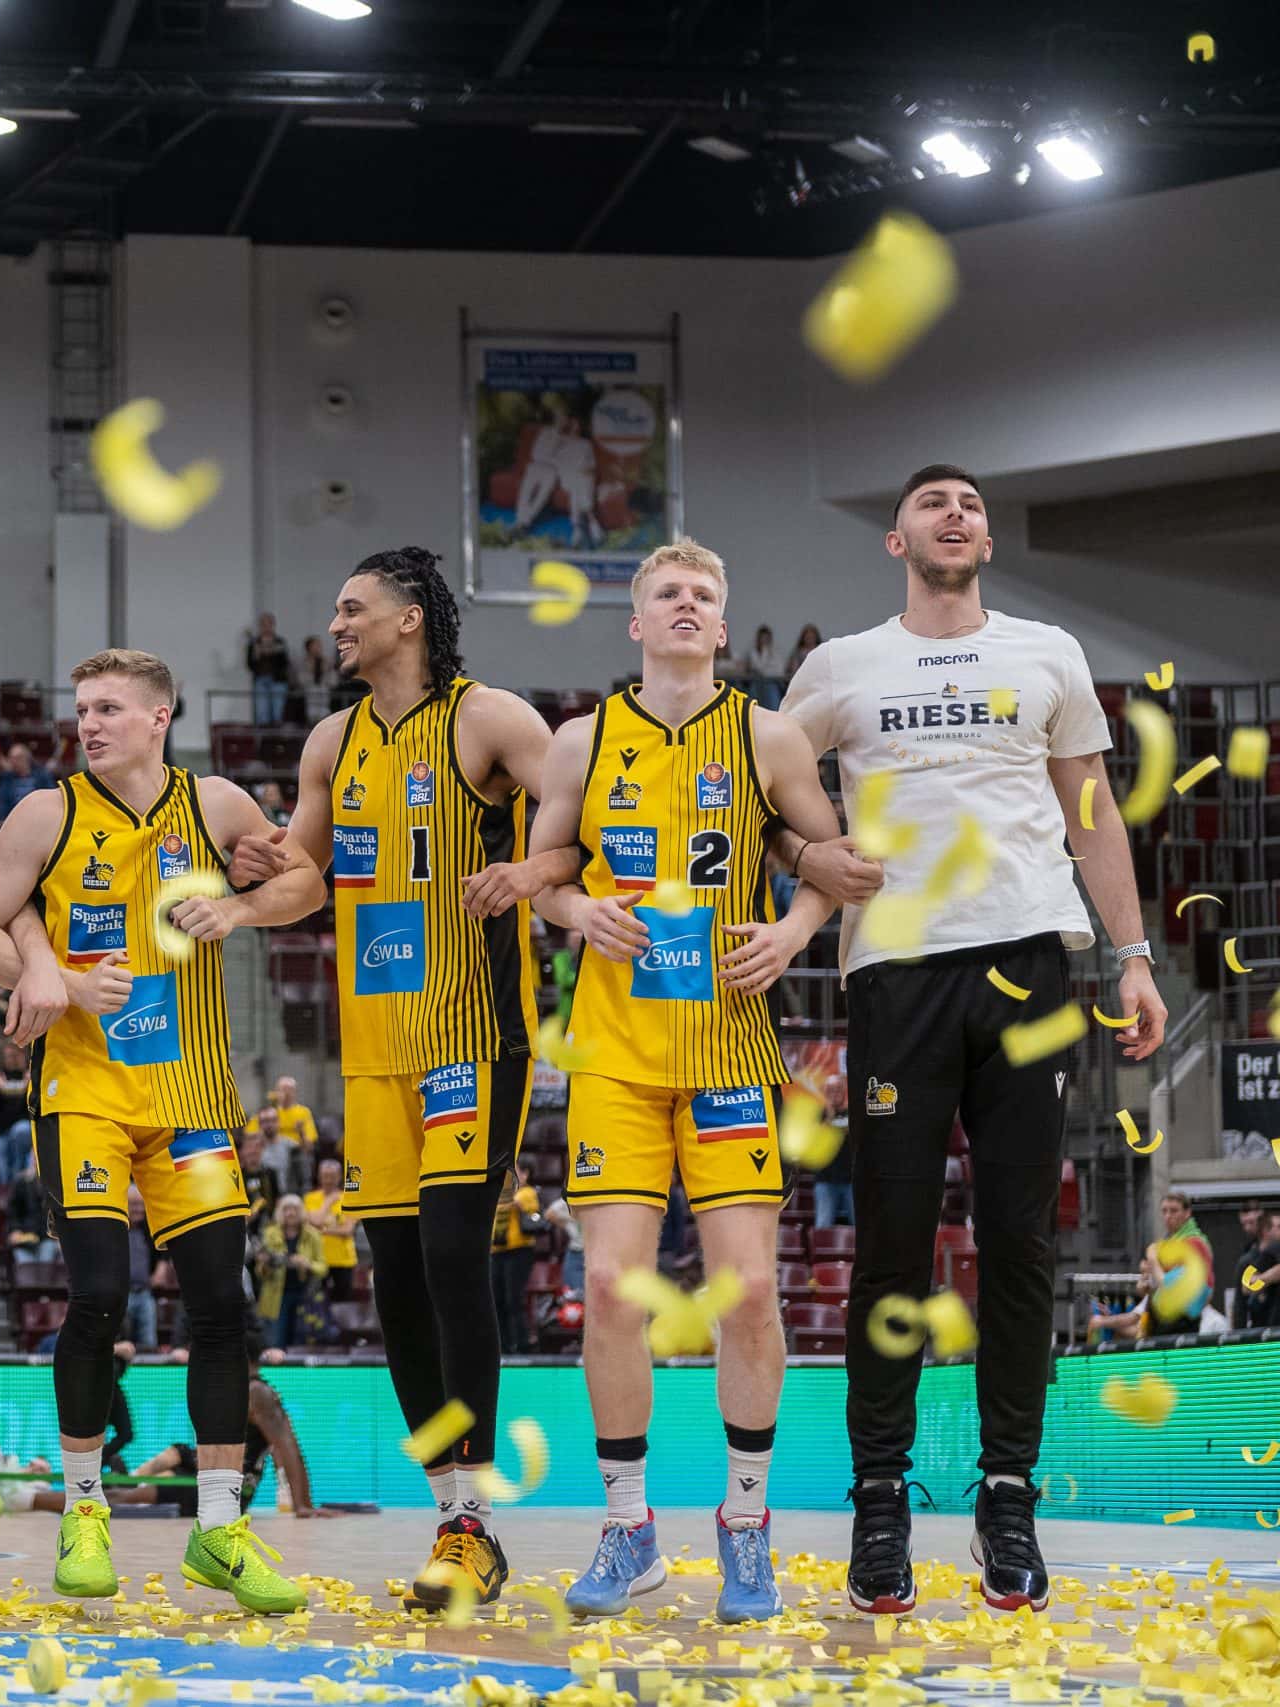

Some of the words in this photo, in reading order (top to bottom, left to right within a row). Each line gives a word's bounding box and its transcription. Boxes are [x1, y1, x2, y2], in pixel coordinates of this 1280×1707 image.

[918, 653, 979, 667] macron
[880, 702, 1020, 732] RIESEN
[410, 792, 430, 804] BBL
[702, 794, 728, 806] BBL
[333, 829, 377, 844] Sparda
[601, 832, 655, 846] Sparda
[346, 843, 377, 856] Bank
[410, 826, 432, 882] 1
[615, 844, 654, 857] Bank
[687, 829, 732, 889] 2
[634, 862, 654, 873] BW
[72, 908, 124, 923] Sparda
[86, 920, 124, 934] Bank
[105, 935, 124, 945] BW
[373, 943, 413, 961] SWLB
[652, 948, 701, 967] SWLB
[128, 1014, 168, 1034] SWLB
[1237, 1053, 1273, 1077] Der
[433, 1076, 473, 1094] Bank
[1238, 1077, 1264, 1101] ist
[452, 1095, 474, 1105] BW
[712, 1091, 762, 1107] Bank
[742, 1108, 764, 1120] BW
